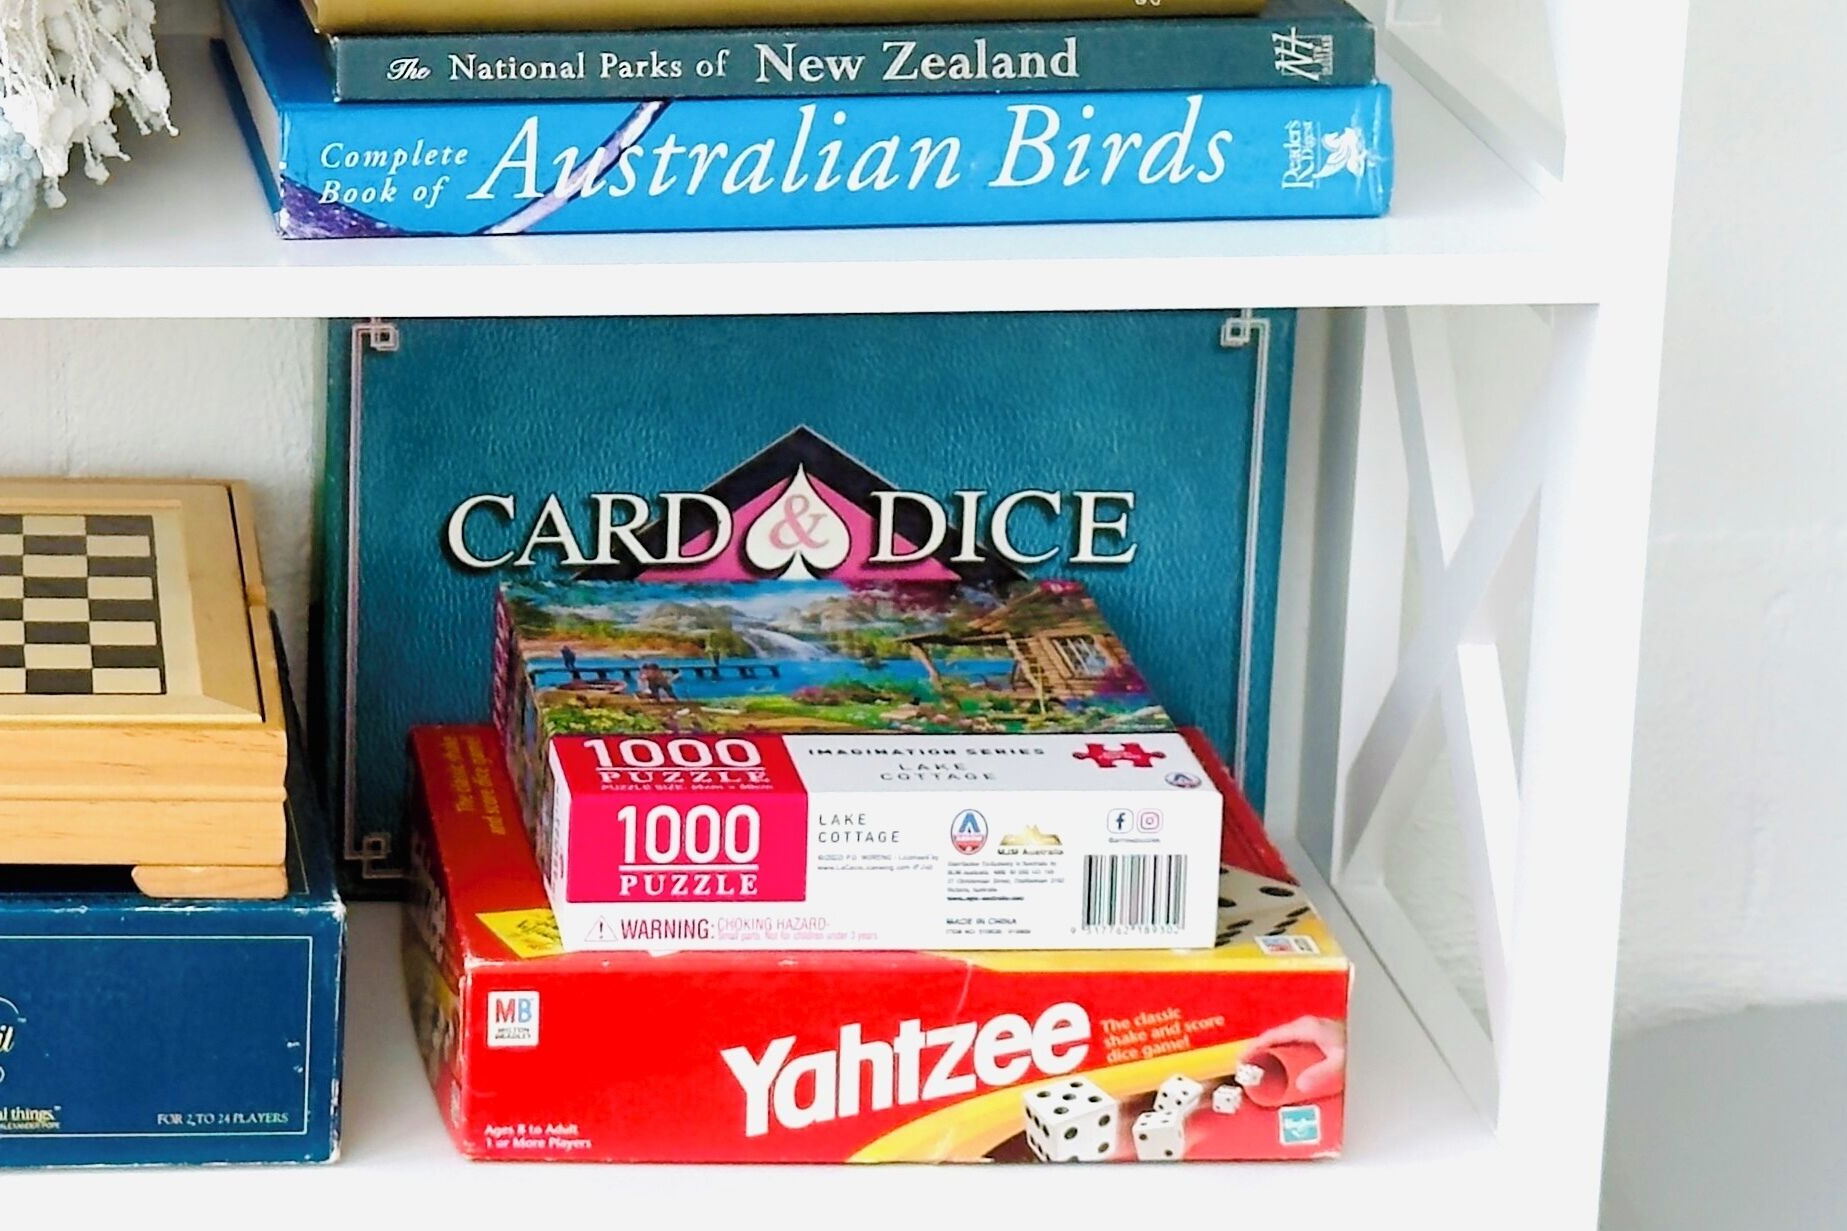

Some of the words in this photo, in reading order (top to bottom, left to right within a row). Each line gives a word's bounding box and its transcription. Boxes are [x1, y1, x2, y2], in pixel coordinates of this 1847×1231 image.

[386, 57, 432, 82] The
[448, 52, 585, 81] National
[599, 52, 683, 80] Parks
[696, 49, 730, 78] of
[754, 43, 866, 84] New
[882, 37, 1080, 82] Zealand
[319, 138, 470, 170] Complete
[466, 102, 962, 201] Australian
[988, 94, 1235, 189] Birds
[1281, 120, 1315, 190] Reader's
[318, 179, 398, 206] Book
[412, 176, 451, 208] of
[446, 490, 734, 567] CARD
[768, 493, 830, 551] &
[868, 488, 1139, 565] DICE
[584, 738, 763, 768] 1000
[807, 748, 957, 756] IMAGINATION
[965, 748, 1046, 756] SERIES
[598, 771, 771, 784] PUZZLE
[880, 772, 998, 781] COTTAGE
[898, 762, 967, 771] LAKE
[819, 813, 867, 826] LAKE
[617, 804, 761, 864] 1000
[818, 830, 900, 843] COTTAGE
[618, 874, 759, 897] PUZZLE
[620, 918, 716, 940] WARNING:
[717, 917, 773, 930] CHOKING
[495, 997, 533, 1024] MB
[1099, 1018, 1131, 1034] The
[1133, 1007, 1183, 1027] classic
[1103, 1030, 1148, 1049] shake
[1150, 1020, 1181, 1040] and
[1183, 1015, 1226, 1033] score
[1106, 1046, 1139, 1065] dice
[1141, 1034, 1191, 1060] game!
[719, 1000, 1093, 1139] Yahtzee
[156, 1113, 184, 1126] FOR
[197, 1112, 216, 1125] TO
[217, 1112, 231, 1124] 24
[232, 1111, 289, 1124] PLAYERS
[484, 1124, 514, 1139] Ages
[528, 1125, 543, 1136] to
[544, 1124, 580, 1136] Adult
[495, 1139, 511, 1148] or
[512, 1137, 547, 1149] More
[548, 1137, 593, 1152] Players
